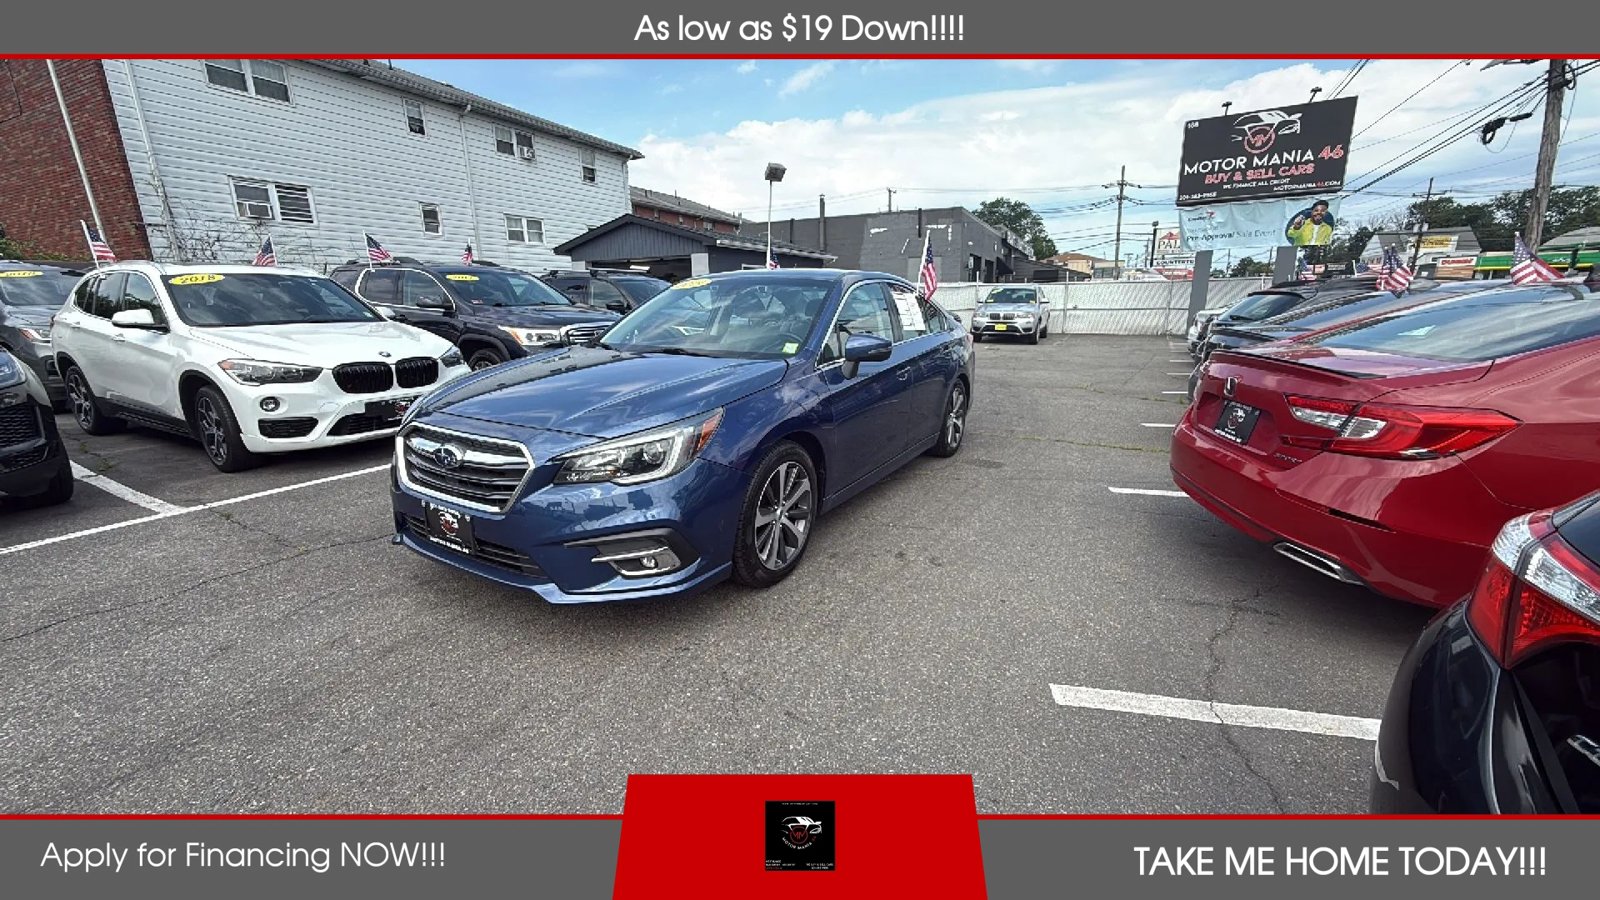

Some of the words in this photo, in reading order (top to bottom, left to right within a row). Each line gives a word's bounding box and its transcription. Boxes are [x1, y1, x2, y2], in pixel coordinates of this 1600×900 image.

[1184, 156, 1247, 176] MOTOR
[1252, 148, 1314, 168] MANIA
[1318, 144, 1344, 160] 46
[1204, 172, 1230, 185] BUY
[1233, 171, 1244, 182] &
[1246, 169, 1276, 181] SELL
[1279, 163, 1315, 177] CARS
[1186, 231, 1236, 243] Pre-Approval
[1254, 229, 1276, 238] Event
[179, 274, 216, 284] 2018
